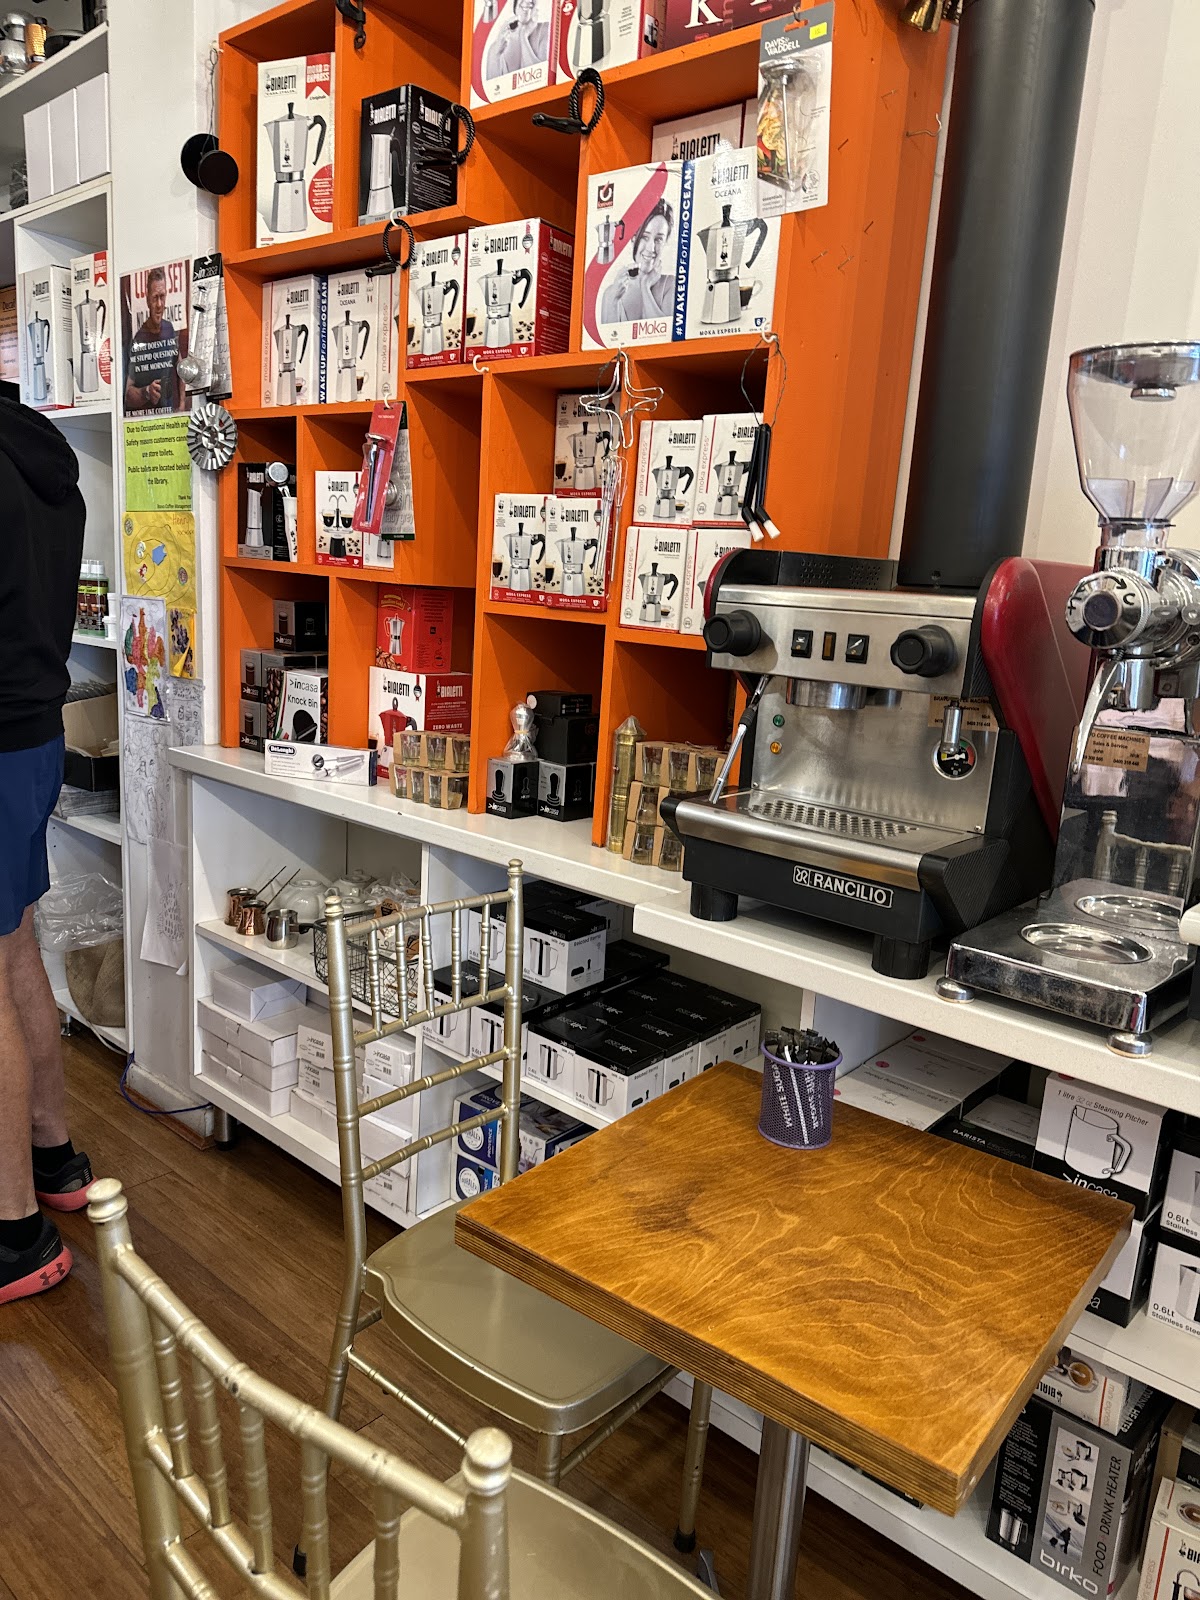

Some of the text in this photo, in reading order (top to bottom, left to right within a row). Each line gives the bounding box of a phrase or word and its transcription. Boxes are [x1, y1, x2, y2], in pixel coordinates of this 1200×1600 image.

[764, 36, 787, 49] DAVIS
[766, 40, 800, 56] WADDELL
[271, 75, 296, 91] BIALETTI
[517, 68, 543, 85] Moka
[374, 104, 397, 125] BIALETTI
[717, 164, 749, 185] BIALETTI
[714, 188, 742, 198] OCEANA
[490, 236, 518, 254] BIALETTI
[426, 249, 449, 267] BIALETTI
[168, 262, 183, 294] SET
[290, 289, 309, 304] BIALETTI
[341, 282, 360, 296] BIALETTI
[638, 320, 667, 335] Moka
[717, 327, 741, 335] EXPRESS
[147, 340, 167, 350] DOESN'T
[137, 352, 152, 362] STUPID
[152, 350, 178, 361] QUESTIONS
[141, 423, 165, 433] Occupational
[166, 421, 180, 429] Health
[180, 420, 188, 428] and
[126, 439, 138, 447] Safety
[154, 436, 175, 444] customers
[672, 432, 696, 445] BIALETTI
[128, 465, 140, 473] Public
[159, 464, 175, 472] located
[176, 463, 190, 471] behind
[331, 481, 349, 492] BIALETTI
[513, 504, 536, 519] BIALETTI
[565, 509, 589, 522] BIALETTI
[658, 541, 681, 553] BIALETTI
[290, 678, 318, 693] >incasa
[387, 680, 410, 697] BIALETTI
[441, 685, 463, 698] BIALETTI
[287, 694, 318, 708] Knock Bin
[1118, 735, 1146, 743] MACHINES
[813, 873, 887, 904] RANCILIO
[770, 1060, 793, 1128] WHITE SUGA
[808, 1095, 819, 1129] SUGAR
[1062, 1091, 1075, 1101] litre
[1075, 1095, 1085, 1103] 32
[1093, 1102, 1124, 1119] Steaming
[1125, 1112, 1149, 1126] Pitcher
[952, 1129, 986, 1145] BARISTA
[1167, 1211, 1190, 1226] 0.6Lt
[1166, 1220, 1198, 1237] Stainless
[1153, 1303, 1175, 1317] 0.6Lt
[1151, 1311, 1200, 1336] Stainless Stee
[1121, 1407, 1141, 1433] HEATER
[1105, 1455, 1122, 1495] HEATER
[1100, 1496, 1115, 1536] DRINK
[1093, 1541, 1107, 1577] FOOD
[1039, 1549, 1099, 1595] birko
